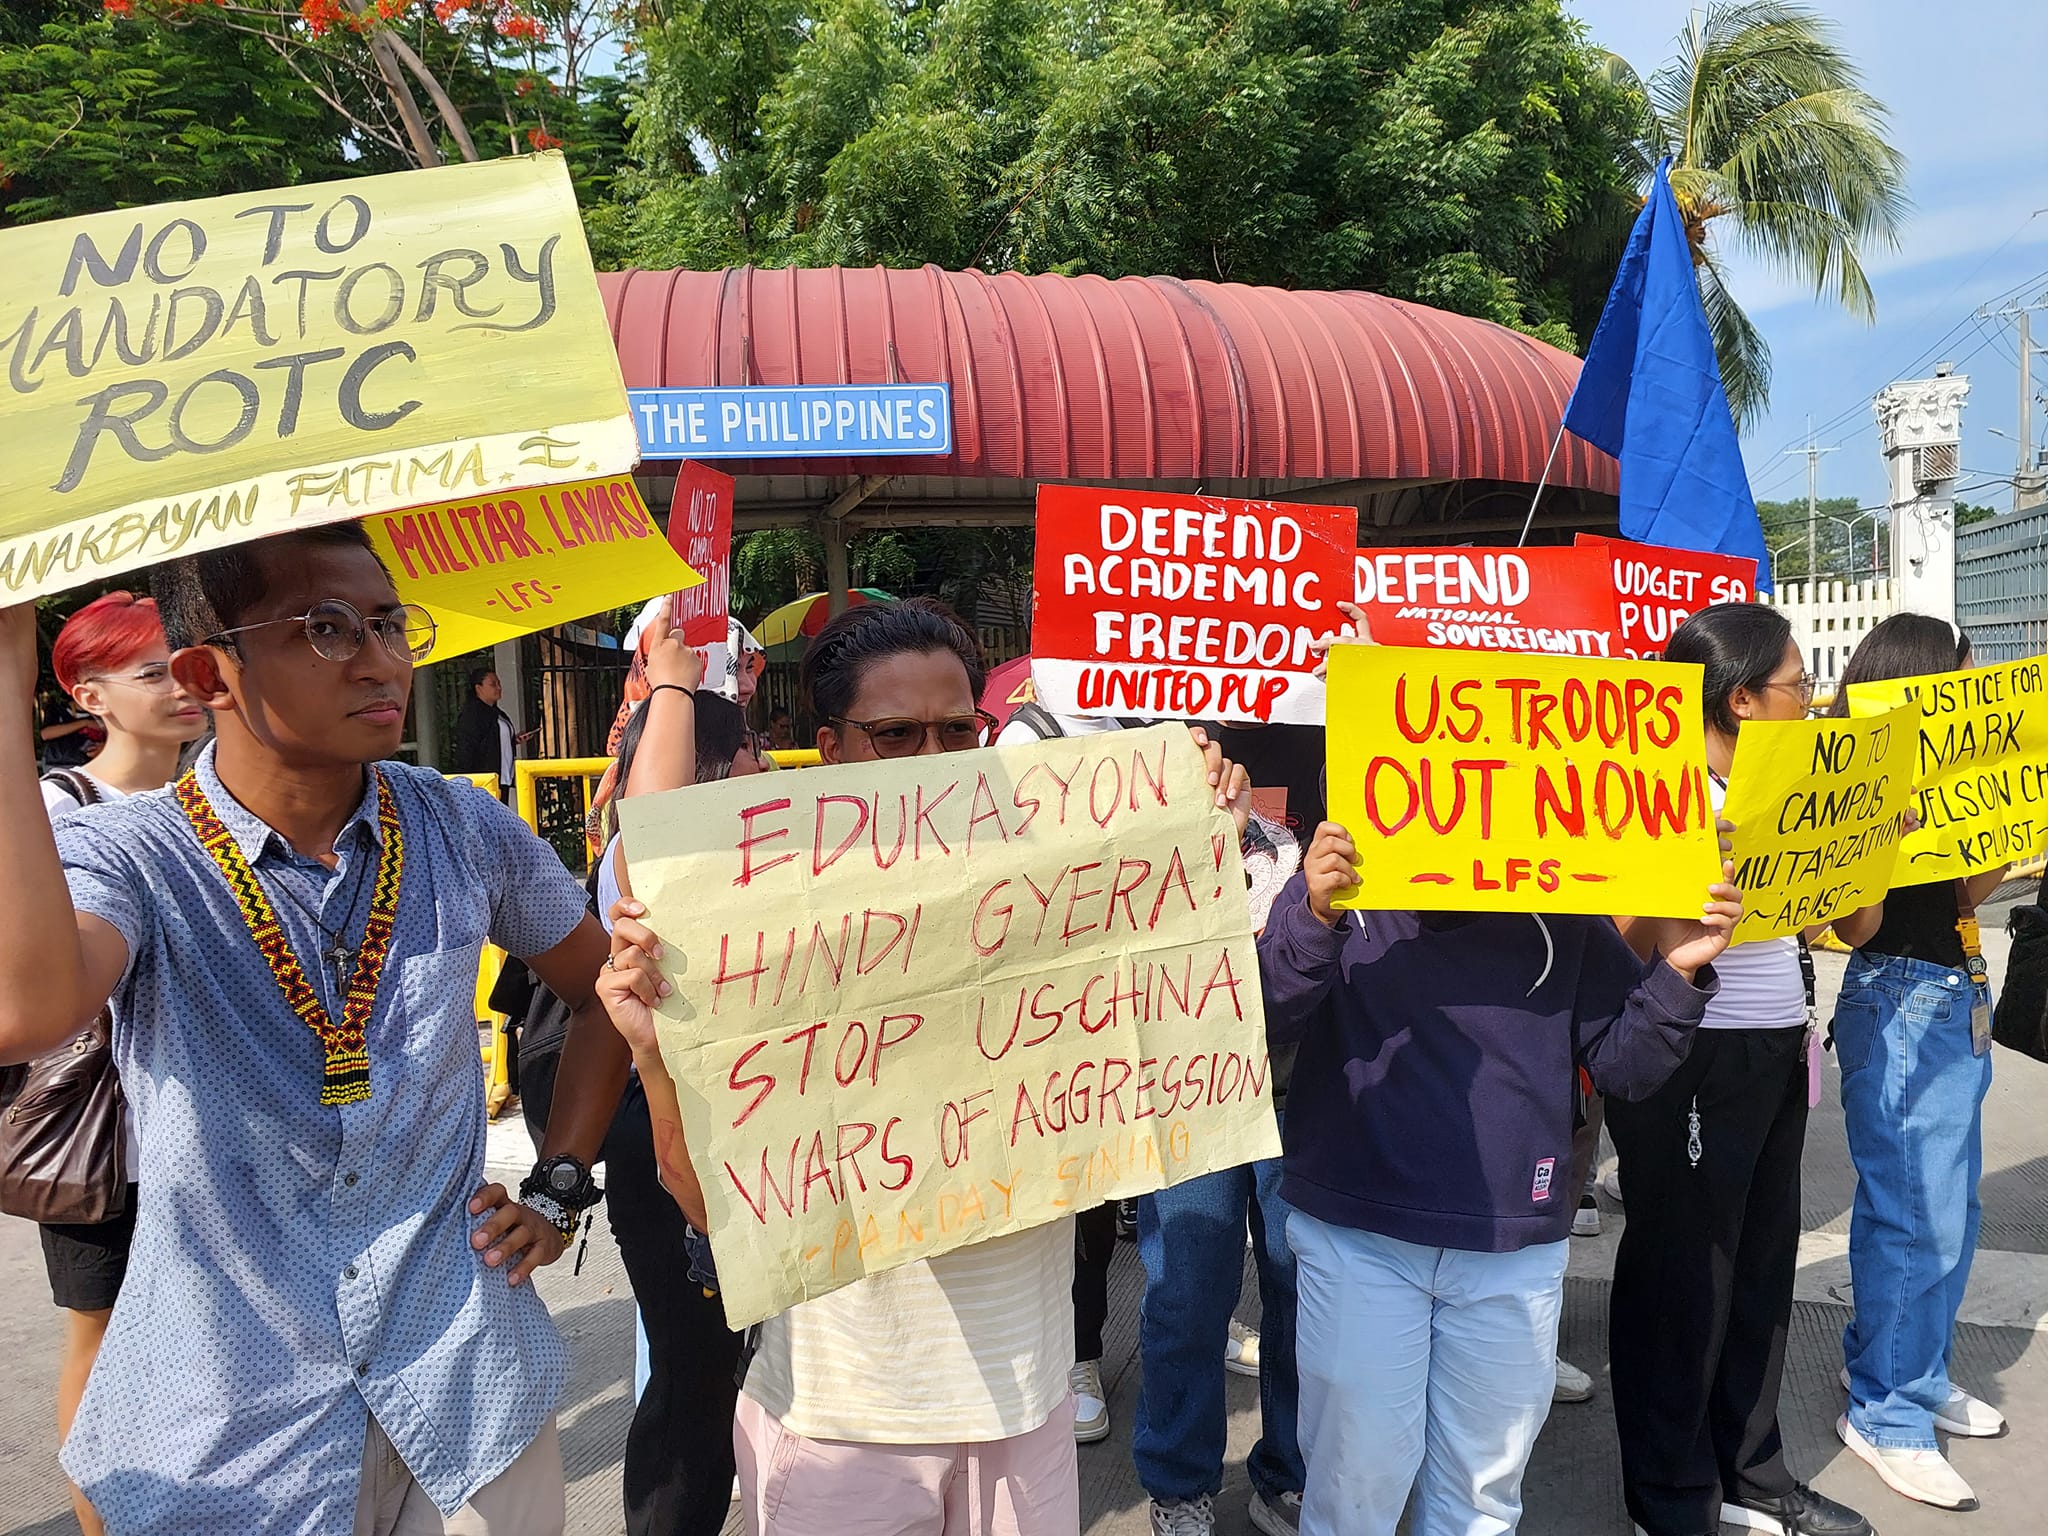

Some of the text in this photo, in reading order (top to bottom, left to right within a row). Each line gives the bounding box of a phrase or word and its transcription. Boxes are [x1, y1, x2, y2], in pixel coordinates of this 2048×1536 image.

[58, 195, 371, 297] NO TO
[50, 341, 423, 493] ROTC
[639, 399, 936, 444] THE PHILIPPINES
[384, 481, 655, 579] MILITAR, LAYAS!
[688, 488, 717, 533] NO TO
[1100, 504, 1302, 563] DEFEND
[688, 536, 713, 566] CAMPUS
[1063, 554, 1322, 610] ACADEMIC
[1355, 554, 1530, 606] DEFEND
[1614, 558, 1747, 606] UDGET SA
[1395, 607, 1521, 625] NATIONAL
[1427, 622, 1612, 657] SOVEREIGNTY
[1077, 668, 1289, 722] UNITED PUP
[2011, 664, 2042, 697] FOR
[1811, 723, 1891, 776] NO TO
[1919, 710, 2025, 777] MARK
[733, 740, 1168, 888] EDUKASYON
[1364, 756, 1705, 841] OUT NOW!
[1778, 774, 1889, 835] CAMPUS
[711, 834, 1225, 1015] HINDI GYERA!
[730, 947, 1243, 1129] STOP US-CHINA
[725, 1051, 1268, 1225] WARS OF AGGRESSION
[1537, 1167, 1550, 1178] Ca
